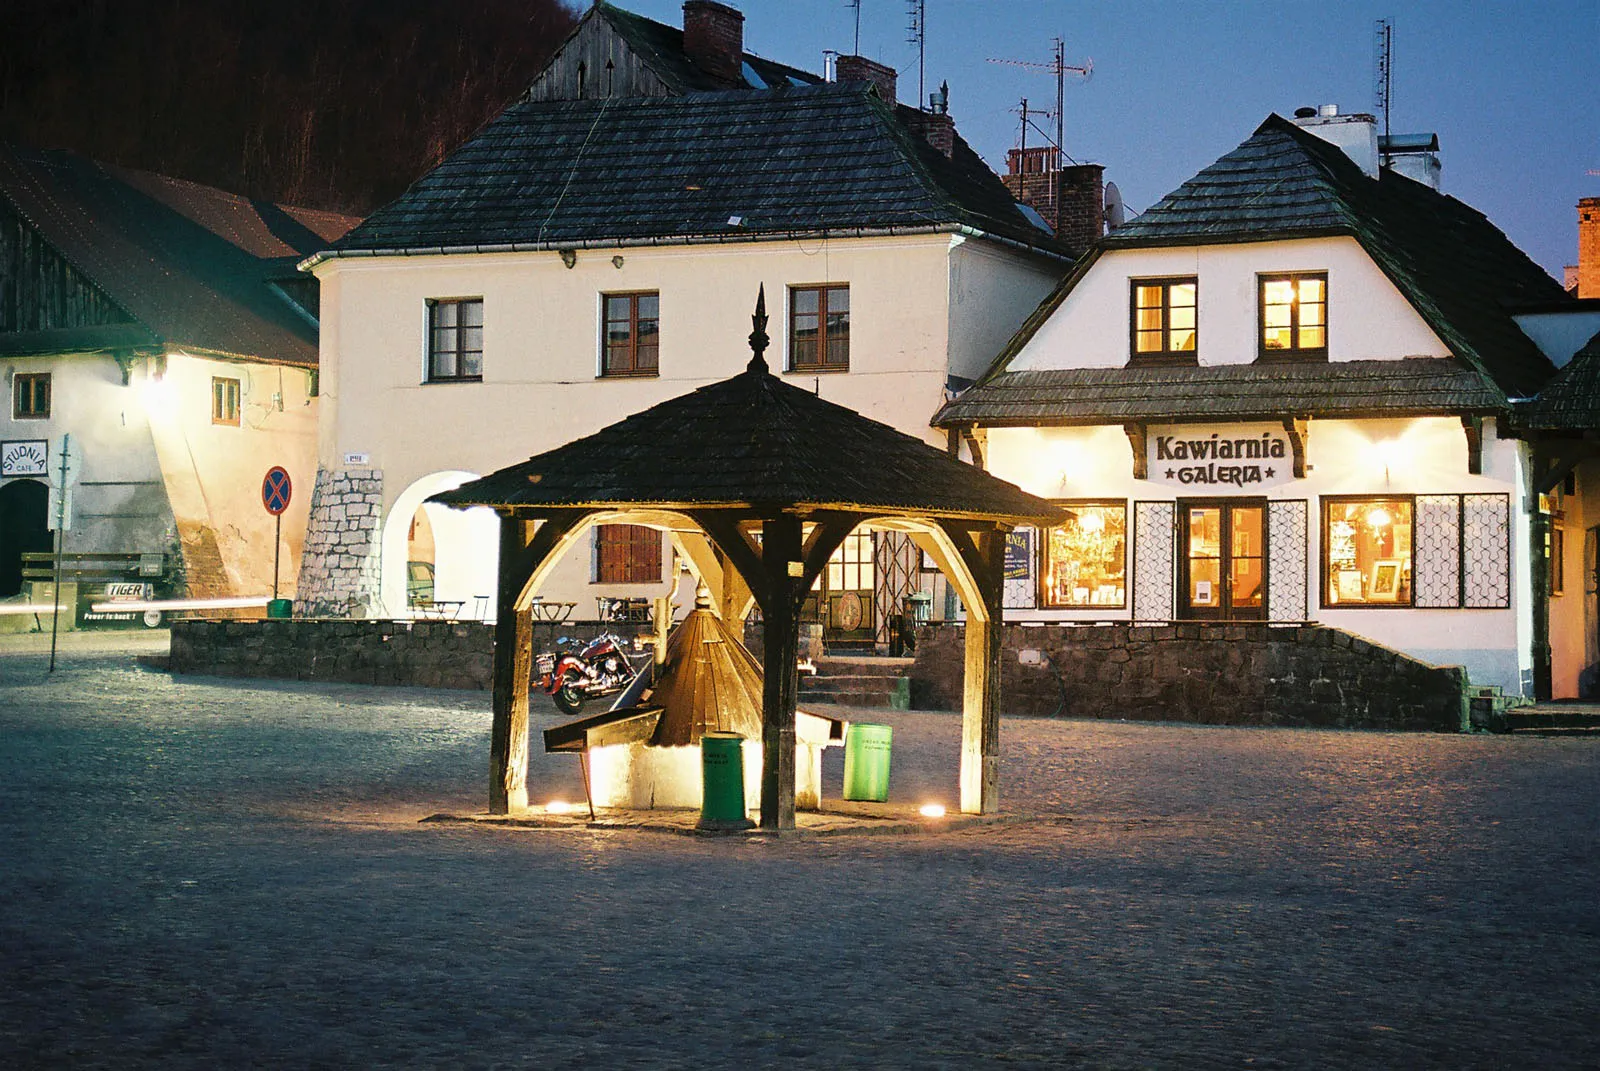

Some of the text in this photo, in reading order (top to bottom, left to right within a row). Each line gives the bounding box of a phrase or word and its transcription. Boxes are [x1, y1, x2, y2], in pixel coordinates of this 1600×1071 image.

[1157, 432, 1285, 460] Kawiarnia
[3, 445, 45, 471] STUDNIA
[1177, 462, 1263, 488] GALERIA
[1005, 533, 1027, 550] RNIA
[110, 584, 142, 596] TIGER
[84, 612, 104, 620] Power
[114, 612, 130, 620] back
